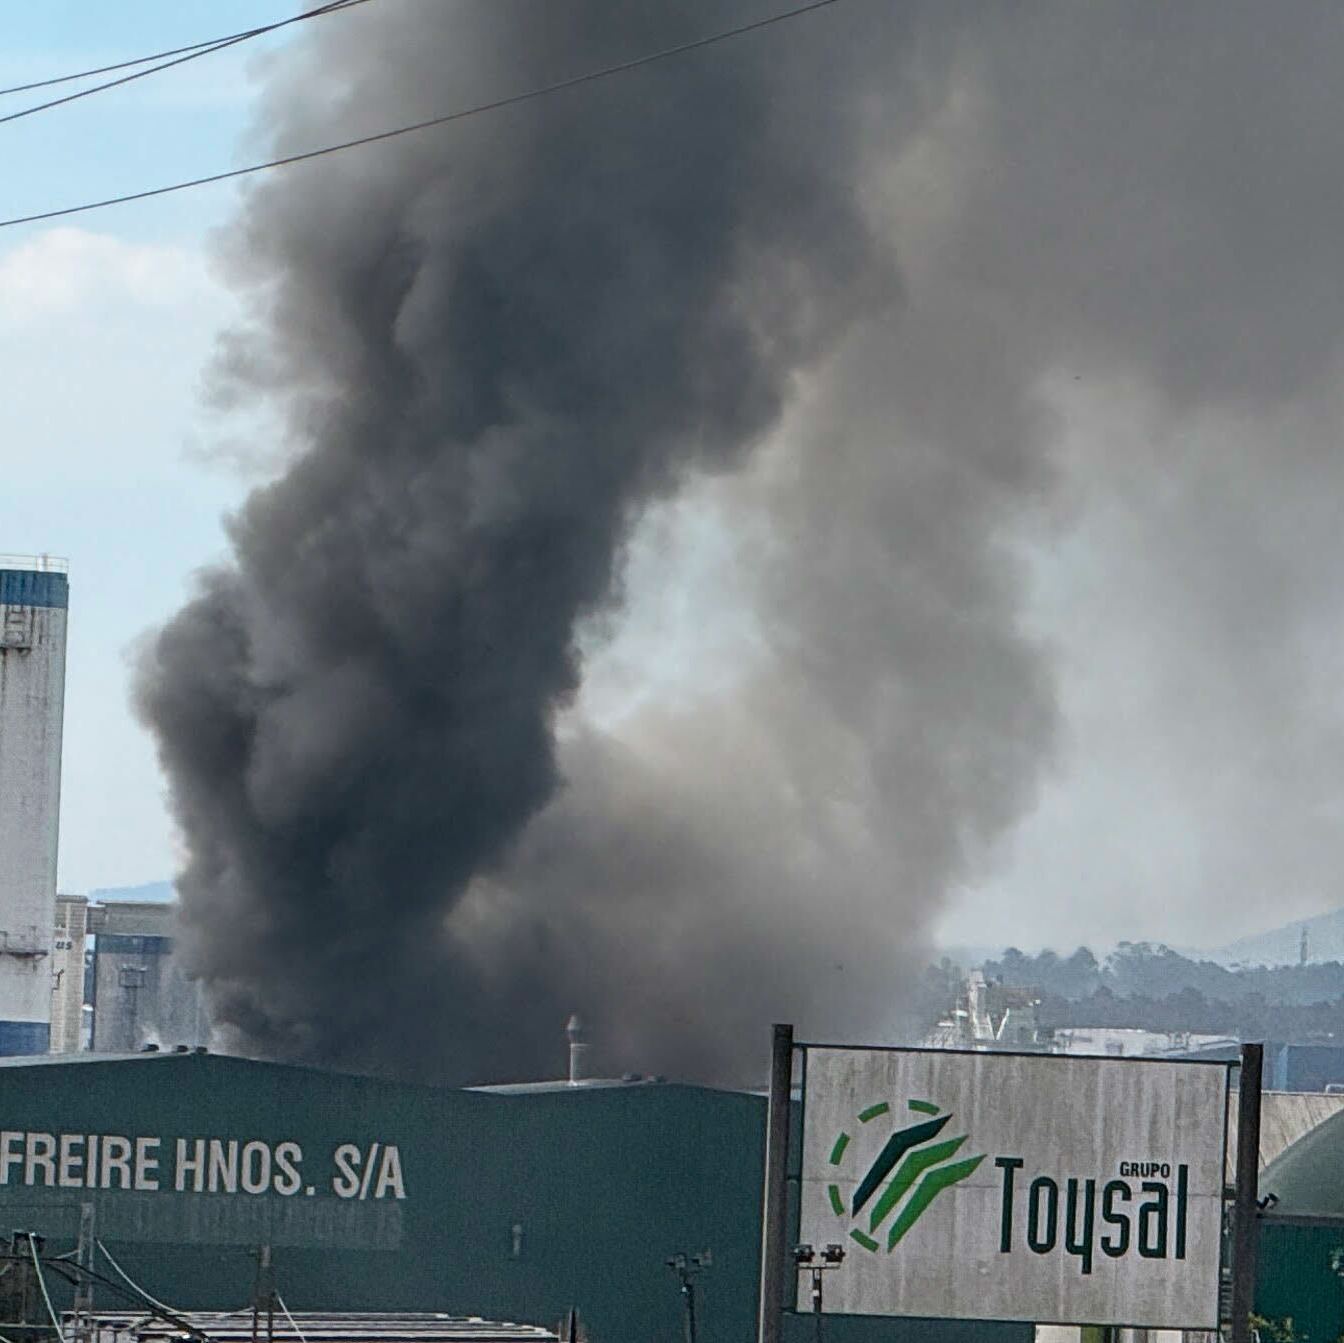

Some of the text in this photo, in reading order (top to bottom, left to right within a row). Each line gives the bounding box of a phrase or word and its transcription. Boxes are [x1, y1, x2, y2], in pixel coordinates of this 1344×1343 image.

[175, 1137, 316, 1197] HNOS.
[332, 1142, 407, 1201] S/A
[1120, 1161, 1171, 1179] GRUPO
[994, 1157, 1189, 1275] Toysal
